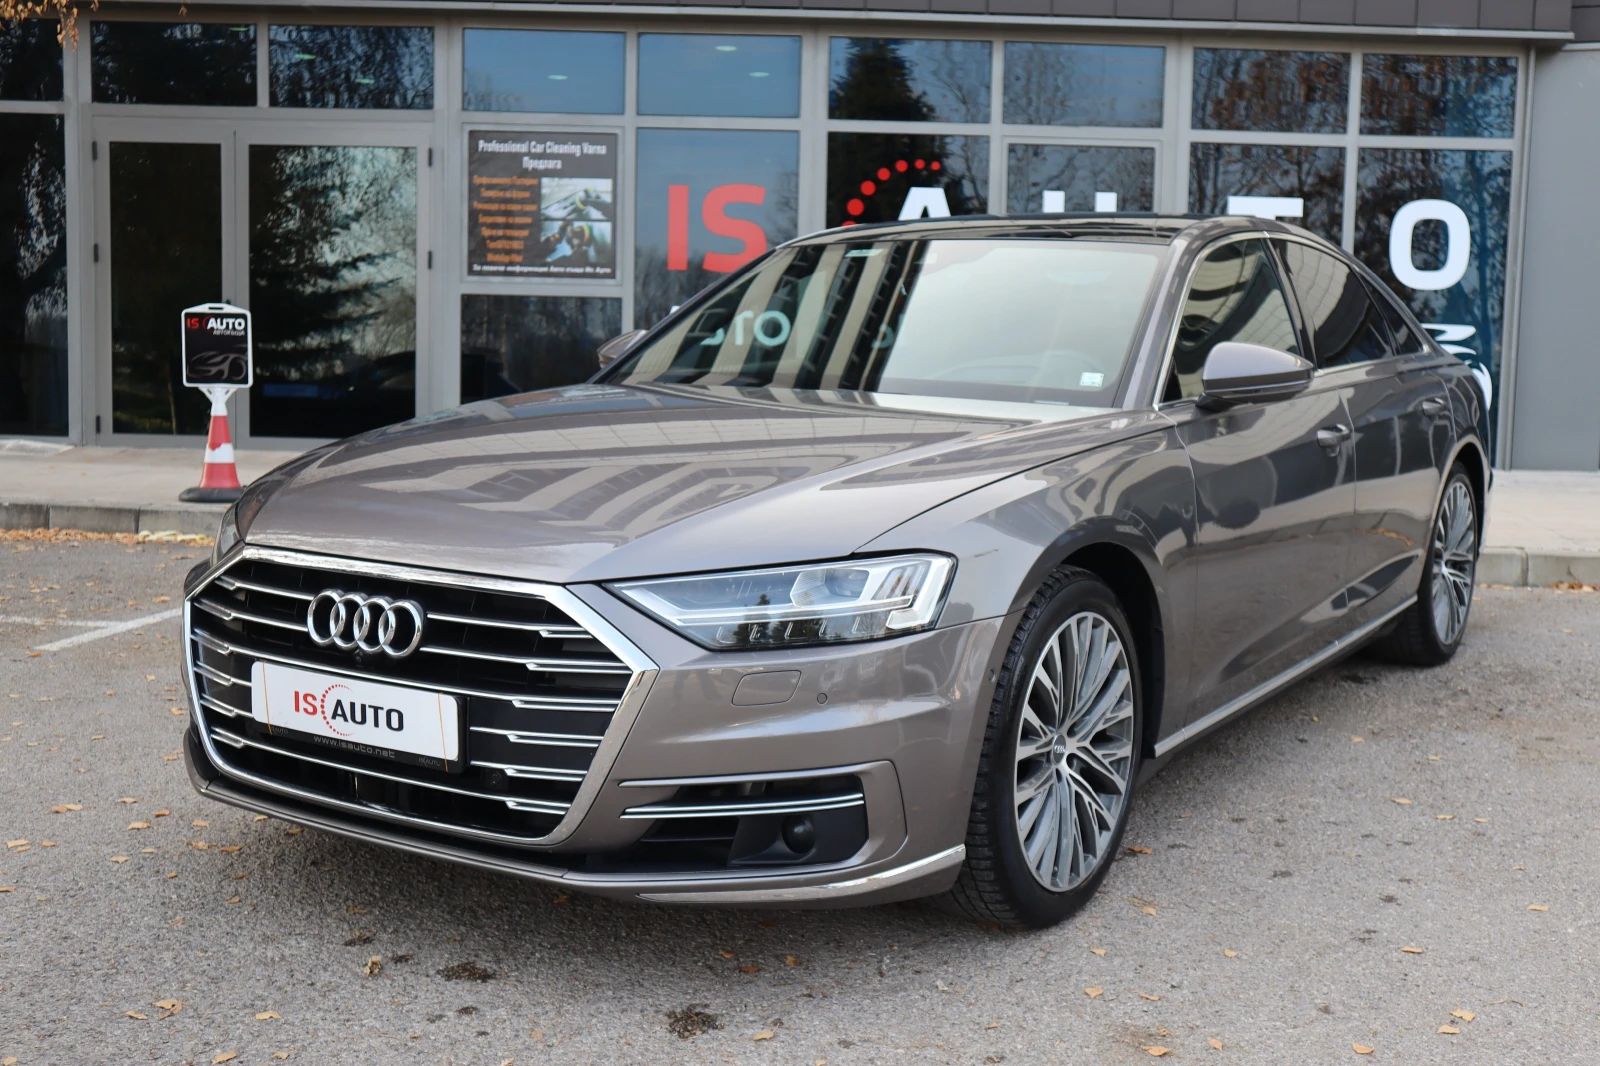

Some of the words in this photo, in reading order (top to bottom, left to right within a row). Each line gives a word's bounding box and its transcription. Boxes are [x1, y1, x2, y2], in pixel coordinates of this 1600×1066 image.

[478, 140, 529, 153] Professional
[530, 141, 545, 153] Car
[546, 141, 581, 157] Cleaning
[582, 142, 607, 154] Varna
[667, 183, 768, 273] IS
[187, 318, 199, 329] IS
[207, 317, 245, 330] AUTO
[294, 690, 318, 716] IS
[331, 699, 404, 732] AUTO
[313, 735, 395, 759] www.isauto.net
